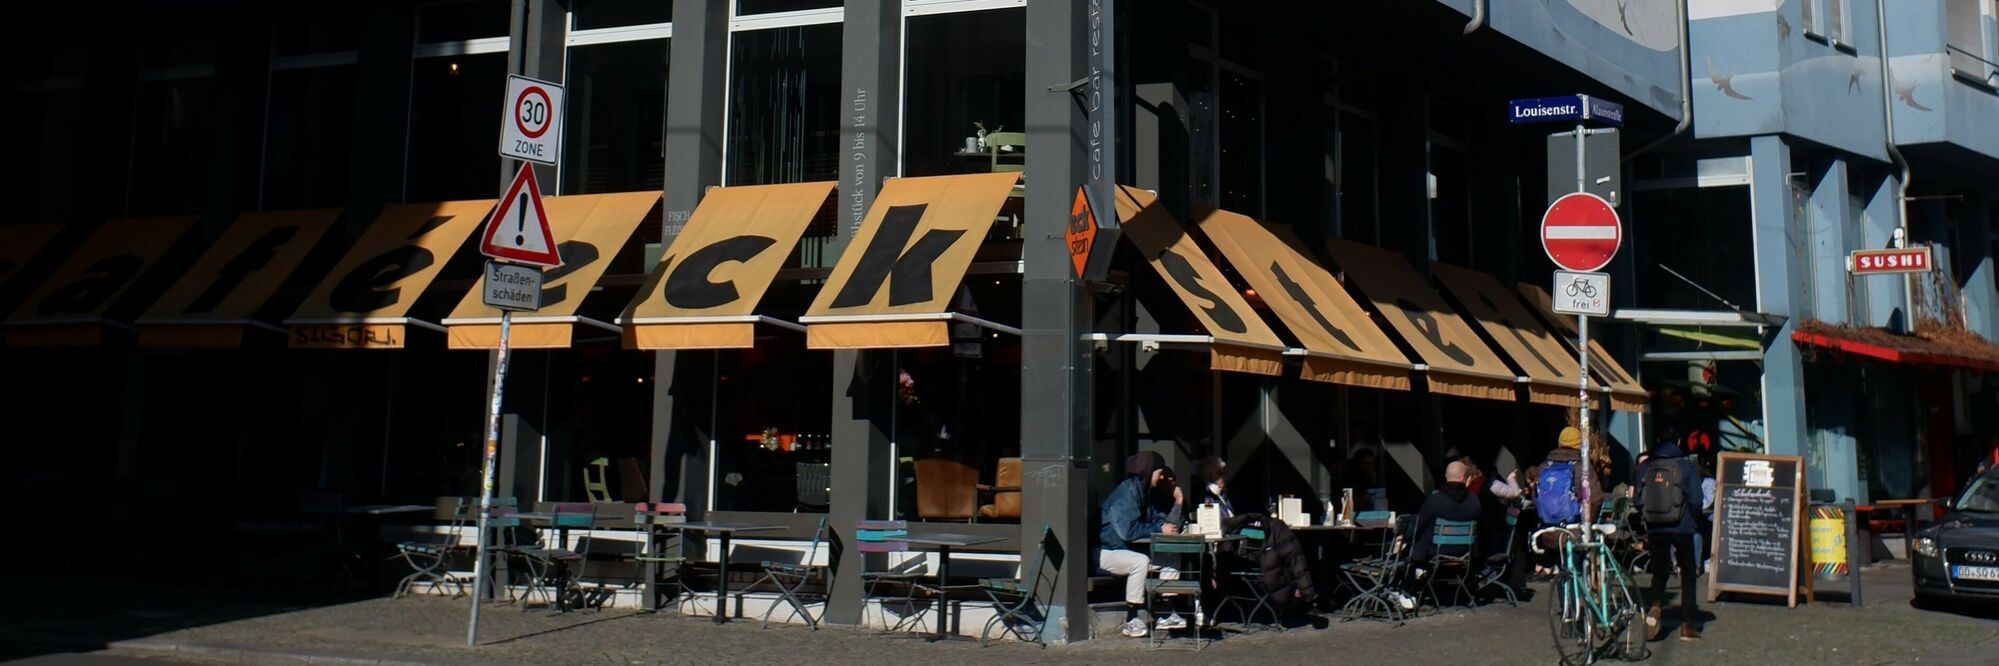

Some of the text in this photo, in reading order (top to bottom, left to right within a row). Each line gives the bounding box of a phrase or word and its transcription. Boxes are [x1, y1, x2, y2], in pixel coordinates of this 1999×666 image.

[1090, 66, 1101, 112] bar
[854, 88, 866, 112] Uhr
[522, 100, 544, 125] 30
[1515, 104, 1578, 118] Louisenstr.
[854, 115, 865, 127] 14
[515, 139, 544, 157] ZONE
[853, 132, 865, 149] bis
[852, 153, 866, 161] 9
[854, 164, 864, 187] von
[1071, 236, 1089, 256] stein
[1860, 254, 1922, 269] SUSHI
[493, 269, 535, 288] Straßen-
[493, 288, 533, 304] schäden
[1572, 299, 1590, 309] frei
